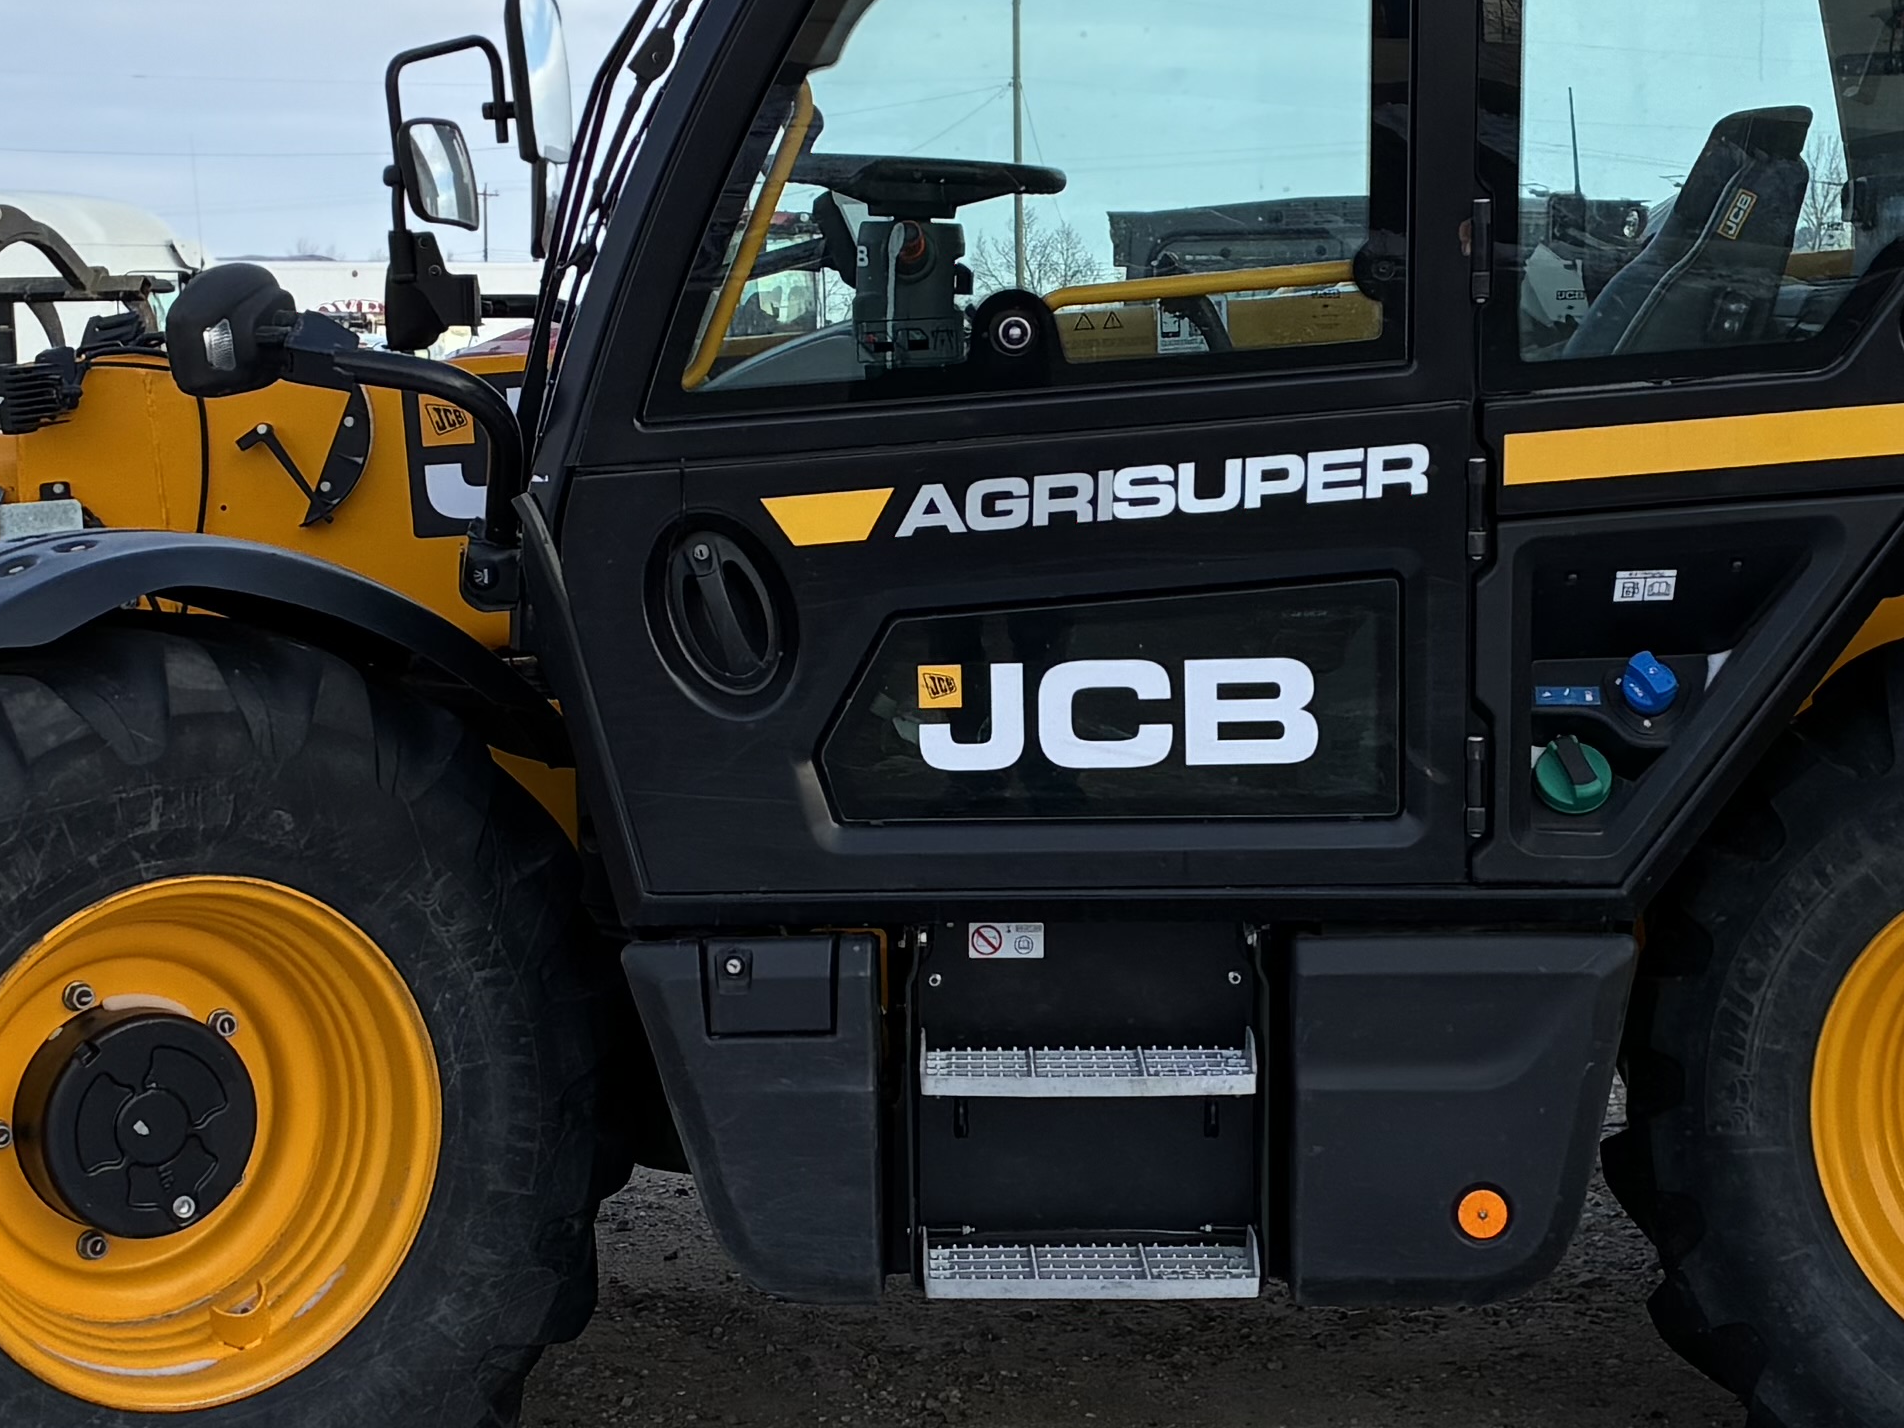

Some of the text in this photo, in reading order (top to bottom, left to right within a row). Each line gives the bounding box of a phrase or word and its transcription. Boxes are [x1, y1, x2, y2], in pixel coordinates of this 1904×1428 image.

[1726, 194, 1753, 236] JCB
[432, 406, 466, 432] JCB
[894, 442, 1430, 539] AGRISUPER
[930, 675, 955, 696] JCB
[918, 657, 1320, 772] JCB
